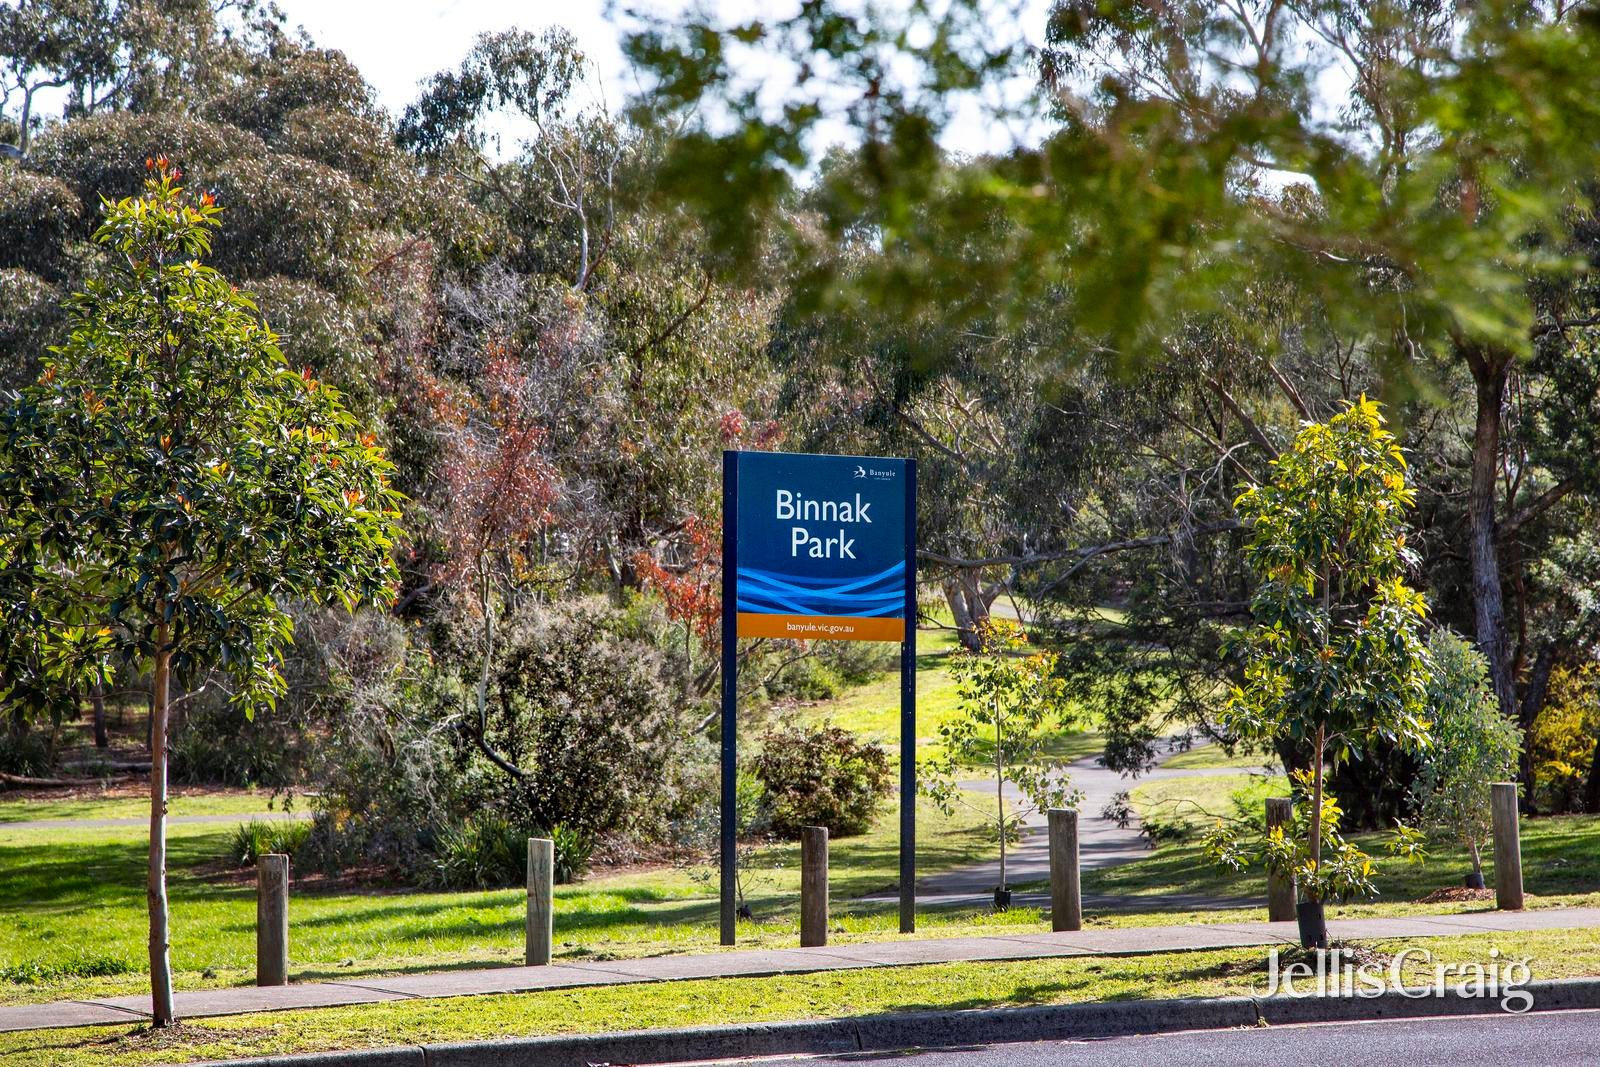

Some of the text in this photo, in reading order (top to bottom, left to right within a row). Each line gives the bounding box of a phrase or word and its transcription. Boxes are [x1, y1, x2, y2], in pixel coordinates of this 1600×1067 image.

[869, 469, 896, 477] Banyule
[776, 489, 872, 523] Binnak
[791, 527, 856, 559] Park
[786, 622, 854, 634] banyule.vic.gov.au
